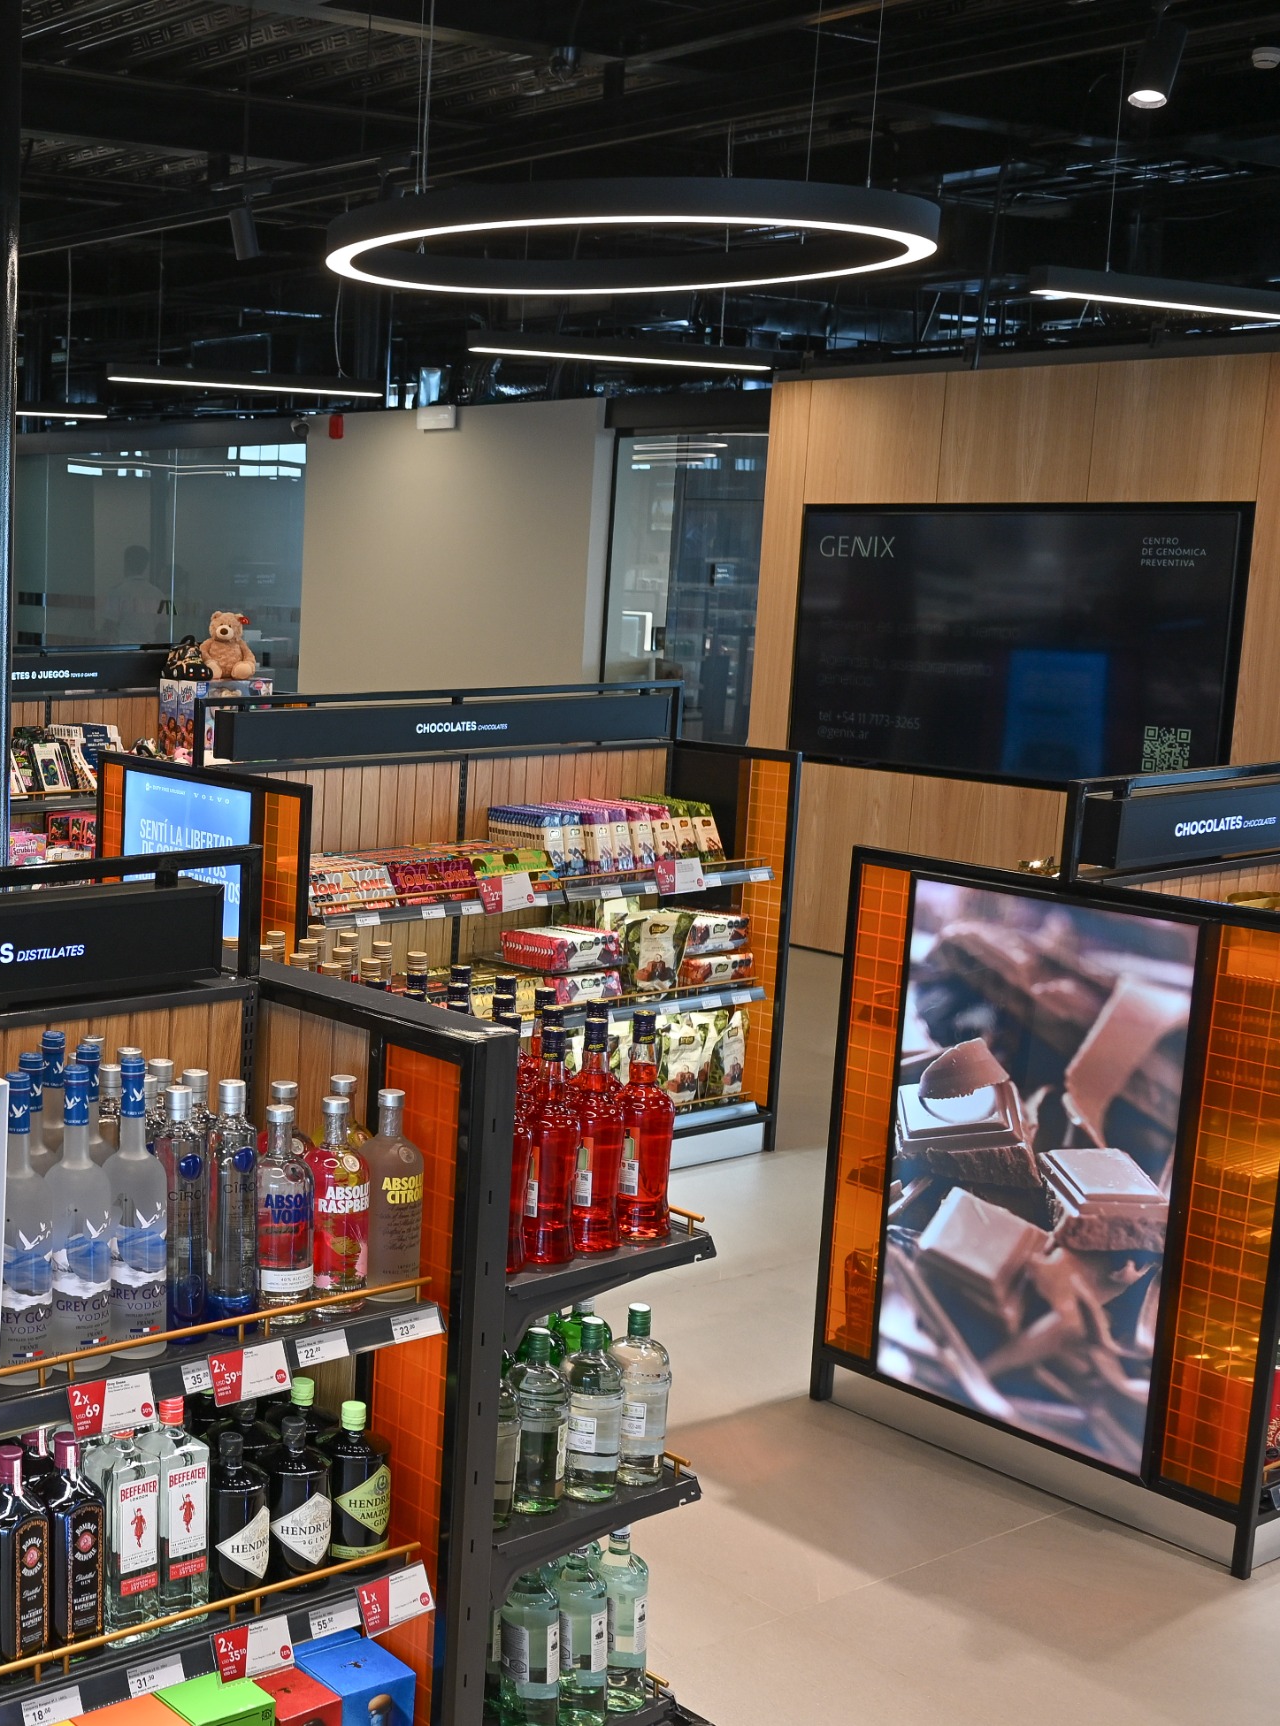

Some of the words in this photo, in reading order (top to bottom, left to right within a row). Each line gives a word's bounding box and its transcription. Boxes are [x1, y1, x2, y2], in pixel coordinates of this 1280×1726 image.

[820, 535, 896, 558] GENIX
[1143, 537, 1179, 545] CENTRO
[1156, 547, 1206, 556] GENÓMICA
[1141, 559, 1195, 567] PREVENTIVA
[38, 670, 70, 678] JUEGOS
[819, 711, 831, 721] tel
[836, 712, 854, 723] +54
[869, 715, 920, 729] 7173-3265
[416, 721, 476, 733] CHOCOLATES
[194, 792, 230, 804] VOLVO
[1175, 815, 1242, 837] CHOCOLATES
[1243, 817, 1276, 828] CHOCOLATES
[140, 818, 169, 840] SENTÍ
[170, 825, 182, 846] LA
[185, 827, 233, 849] LIBERTAD
[16, 944, 84, 962] DISTILLATES
[56, 1300, 87, 1312] GREY
[127, 1300, 162, 1310] VODKA
[78, 1311, 109, 1322] VODKA
[9, 1324, 46, 1334] VODKA
[212, 1360, 226, 1373] 2x
[72, 1391, 89, 1406] 2x
[86, 1404, 100, 1417] 69
[169, 1467, 206, 1488] BEEFEATER
[179, 1480, 197, 1488] LONDON
[120, 1480, 157, 1502] BEEFEATER
[130, 1494, 149, 1502] LONDON
[374, 1516, 388, 1527] GIN
[75, 1522, 97, 1536] BOMBAY
[22, 1537, 42, 1550] BOMBAY
[74, 1548, 97, 1562] BRAMBLE
[22, 1562, 42, 1577] BRAMBLE
[74, 1593, 97, 1604] BLACKBERRY
[21, 1608, 43, 1621] BLACKBERRY
[372, 1604, 381, 1614] 51
[218, 1638, 234, 1653] 2x
